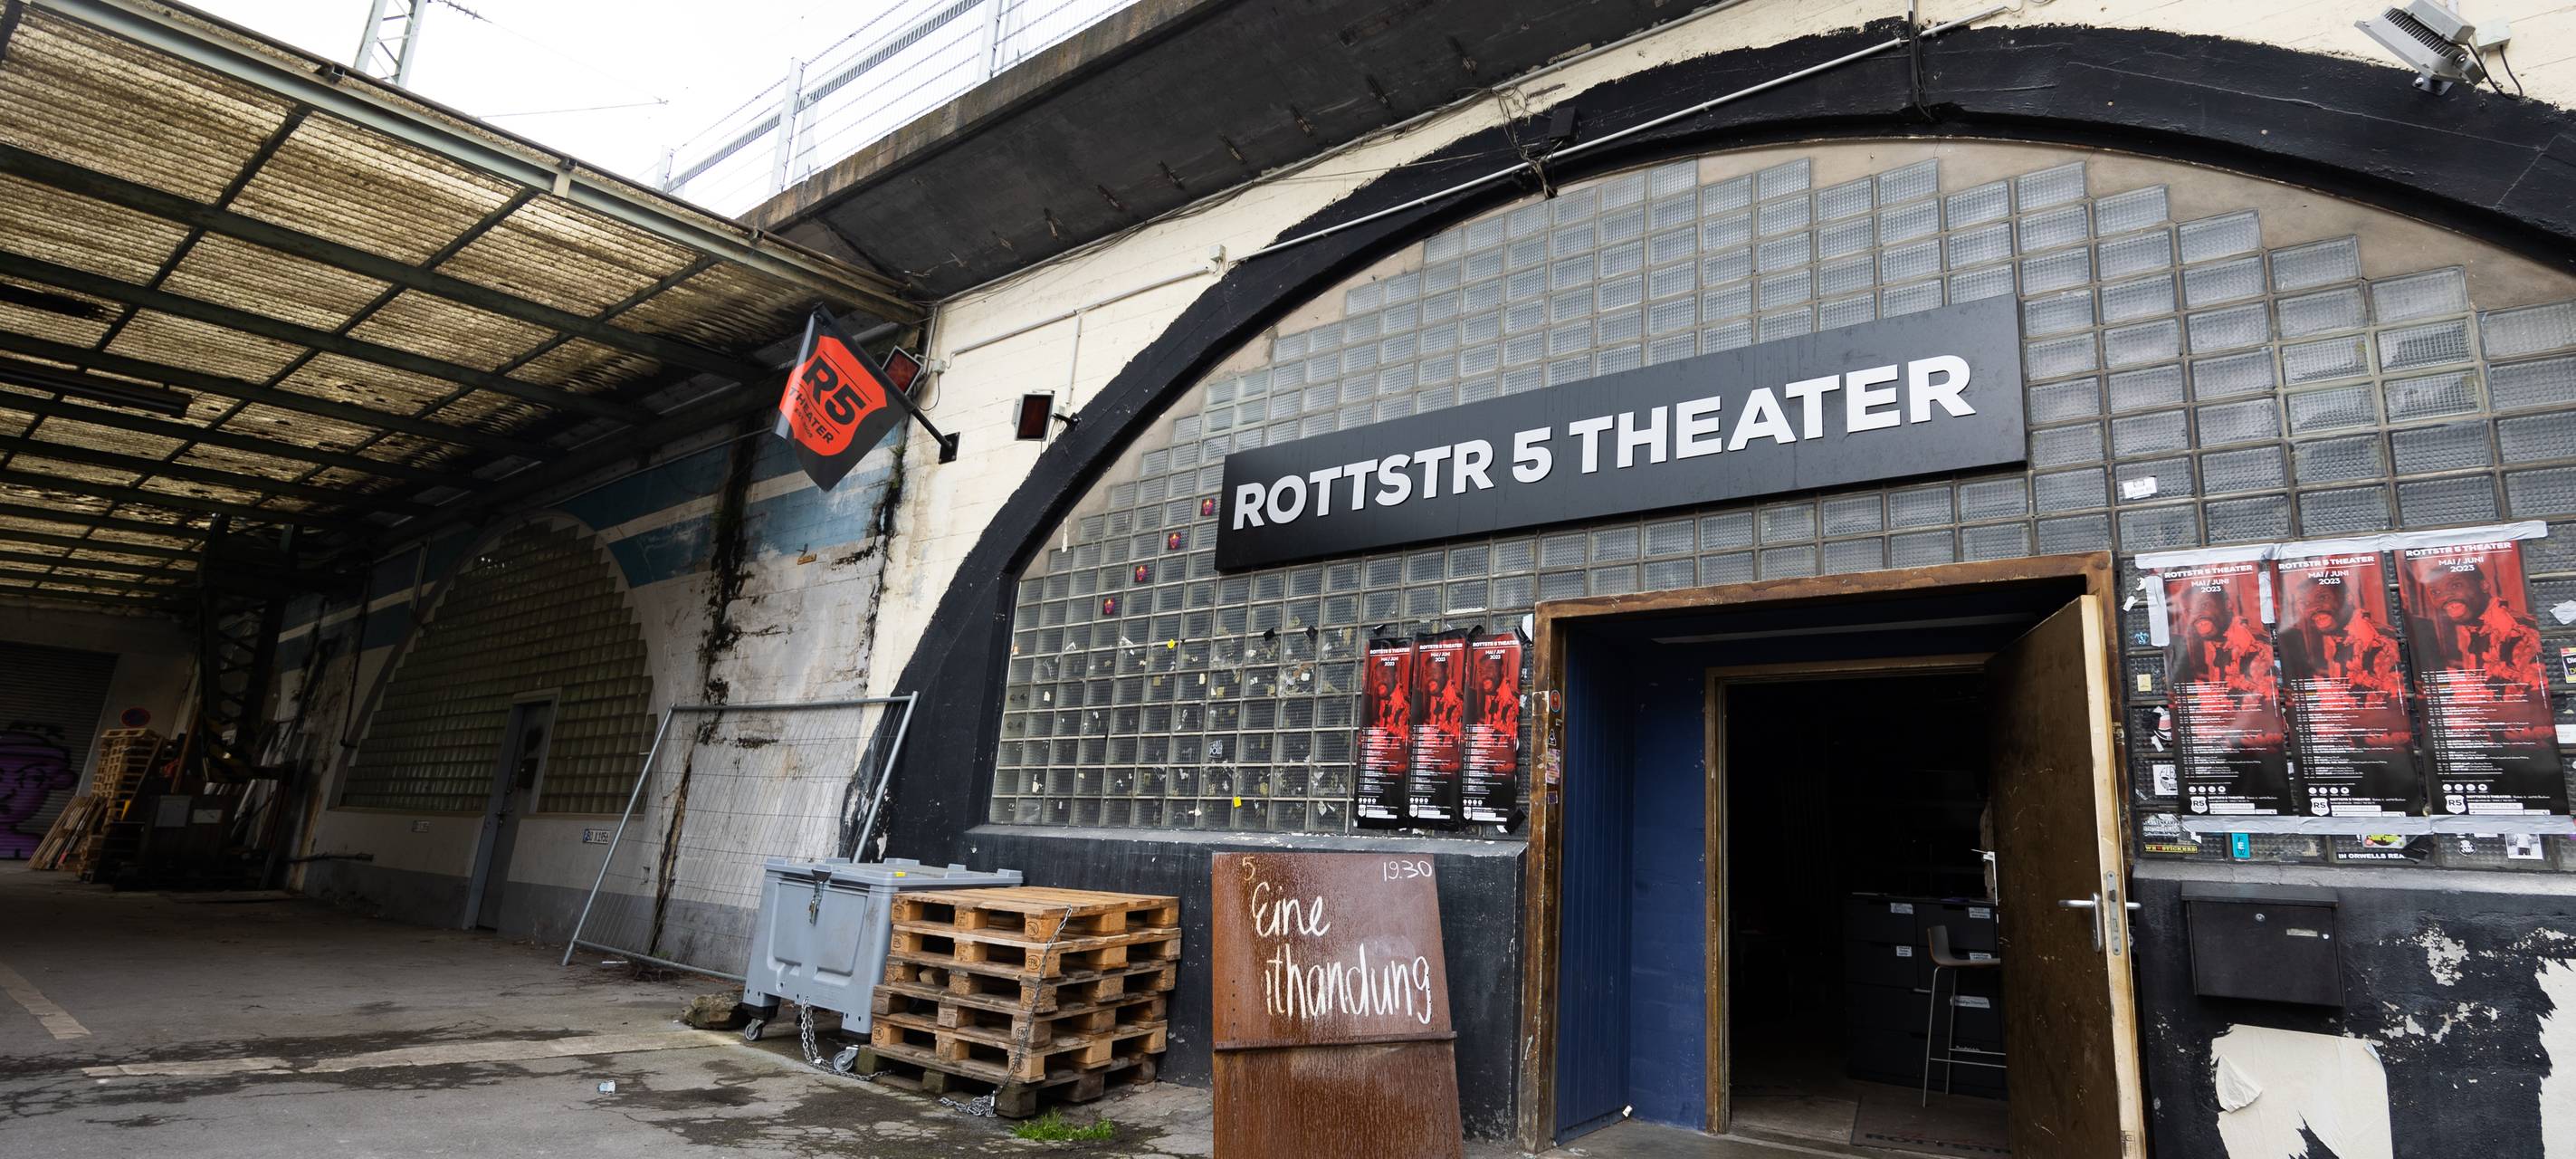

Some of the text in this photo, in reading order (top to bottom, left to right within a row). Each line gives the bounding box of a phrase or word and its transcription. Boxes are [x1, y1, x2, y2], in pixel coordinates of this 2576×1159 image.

[802, 356, 866, 425] R5
[789, 387, 834, 444] THEATER
[1233, 355, 1976, 530] ROTTSTR 5 THEATER
[2405, 547, 2453, 557] ROTTSTR
[2462, 541, 2512, 551] THEATER
[2278, 560, 2321, 570] ROTTSTR
[2330, 556, 2375, 565] THEATER
[2463, 556, 2485, 564] JUNI
[2164, 569, 2203, 579] ROTTSTR
[2212, 564, 2253, 574] THEATER
[2200, 585, 2221, 593] 2023
[2212, 578, 2230, 586] JUNI
[1383, 860, 1433, 882] 19.30
[1252, 881, 1331, 937] Eine
